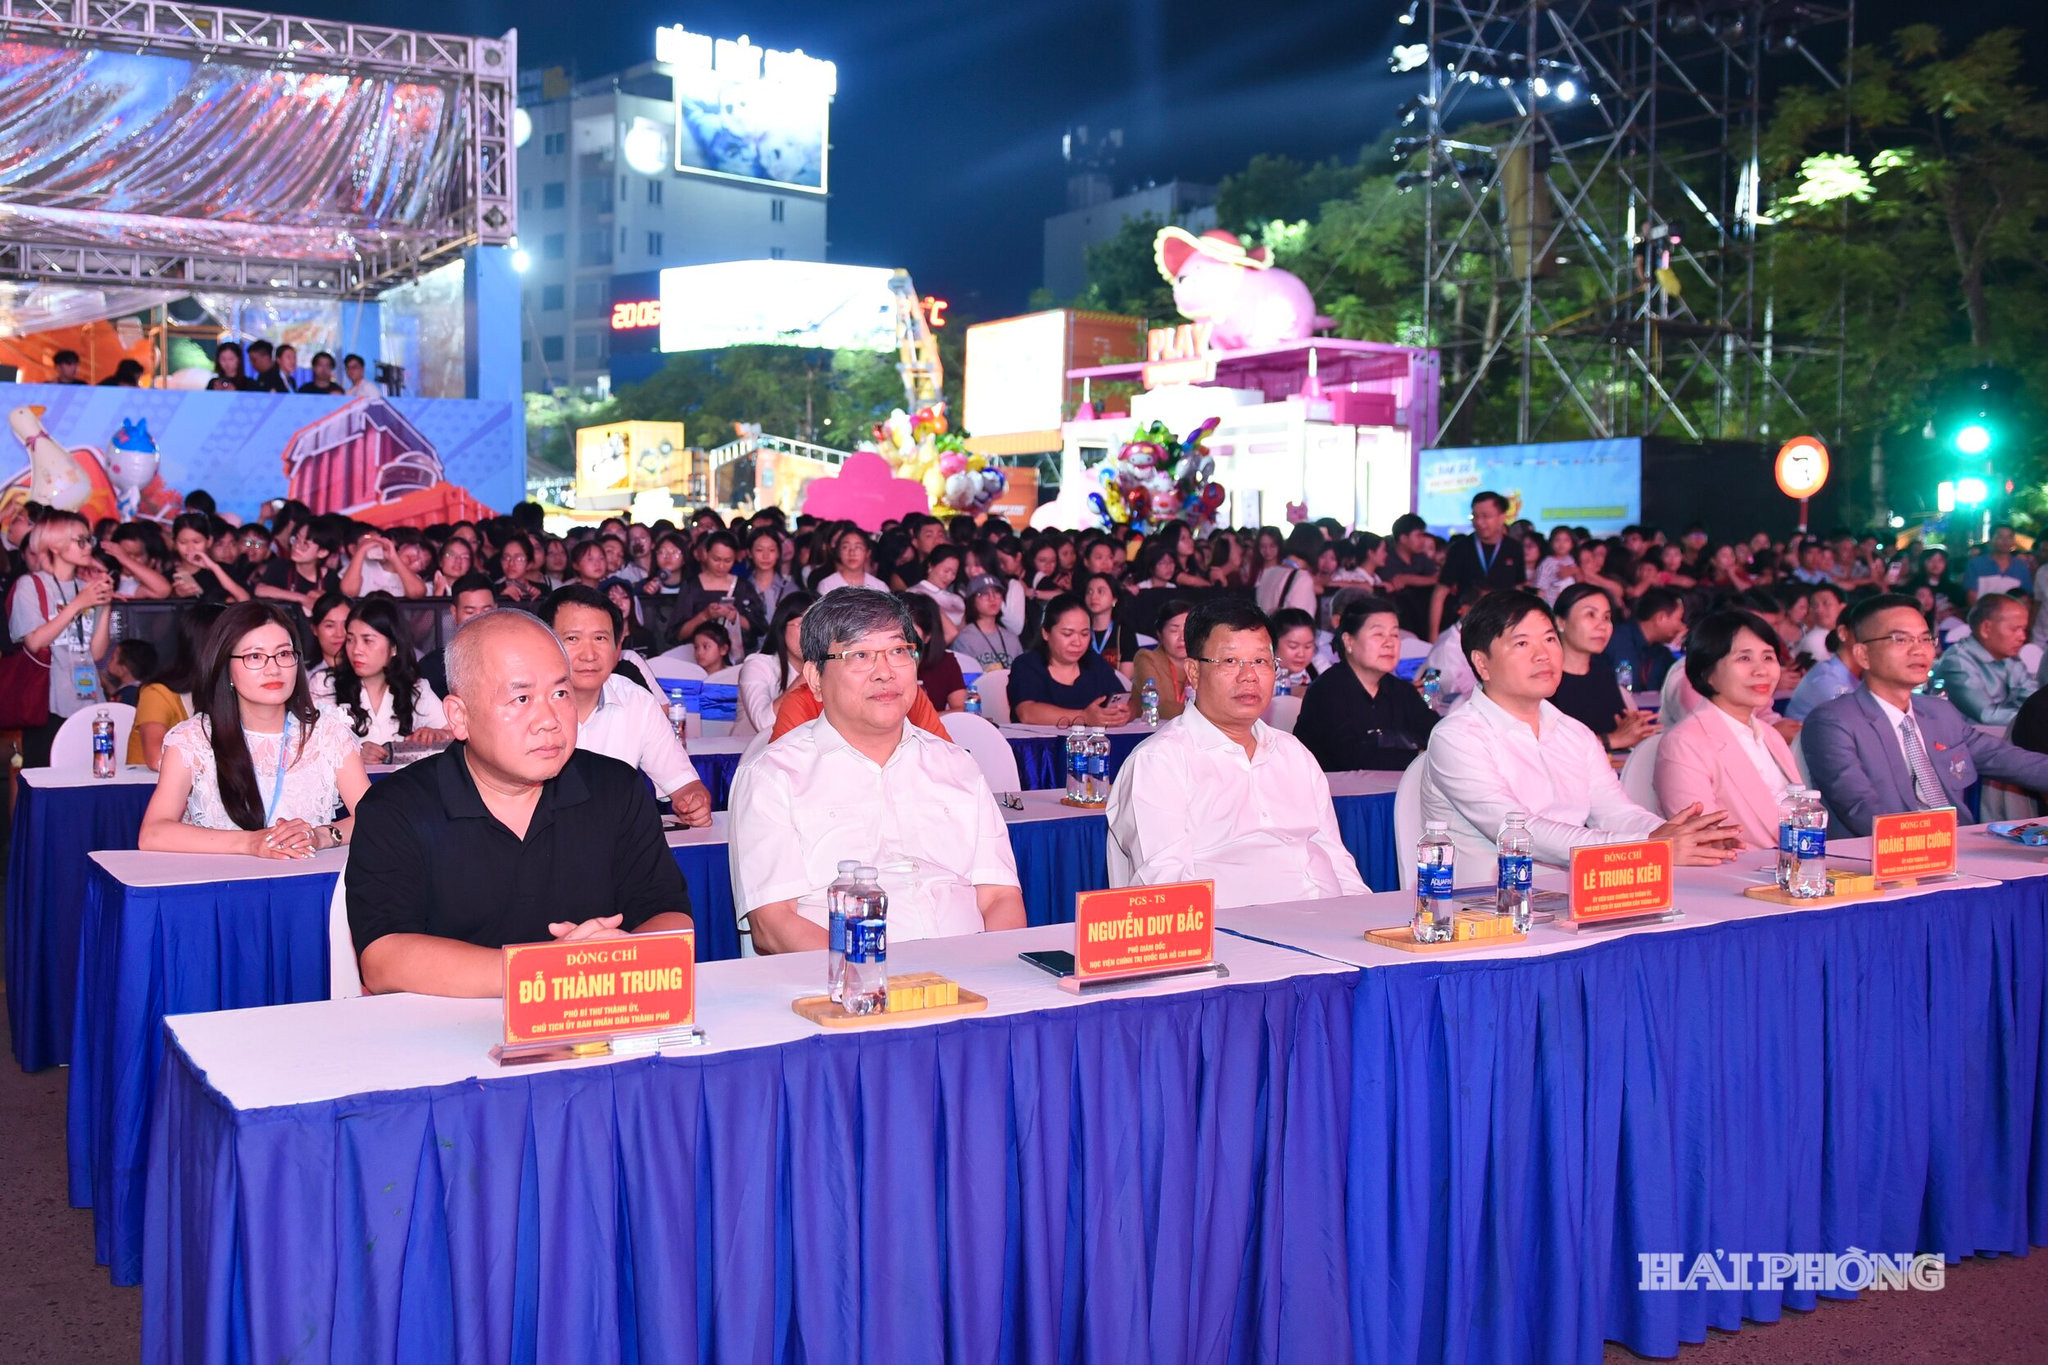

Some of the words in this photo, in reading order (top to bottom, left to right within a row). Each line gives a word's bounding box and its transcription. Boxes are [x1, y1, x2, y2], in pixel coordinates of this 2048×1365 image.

[1148, 322, 1213, 361] PLAY
[1583, 869, 1596, 890] LÊ
[1599, 868, 1634, 888] TRUNG
[1637, 862, 1662, 883] KIÊN
[1129, 896, 1147, 906] PGS
[1154, 894, 1166, 904] TS
[1088, 912, 1143, 943] NGUYỄN
[1147, 914, 1174, 936] DUY
[1177, 905, 1204, 933] BẮC
[566, 950, 608, 966] ĐỒNG
[612, 946, 637, 961] CHÍ
[519, 971, 546, 1004] ĐỖ
[552, 971, 615, 1001] THÀNH
[621, 967, 682, 994] TRUNG
[532, 1022, 546, 1033] CHỦ
[548, 1022, 564, 1033] TỊCH
[577, 1020, 592, 1029] BAN
[593, 1017, 613, 1028] NHÂN
[615, 1015, 630, 1025] DÂN
[631, 1013, 654, 1024] THÀNH
[656, 1010, 670, 1021] PHỐ
[563, 1009, 578, 1018] PHÓ
[580, 1008, 588, 1017] BÍ
[589, 1007, 603, 1016] THƯ
[604, 1005, 627, 1015] THÀNH
